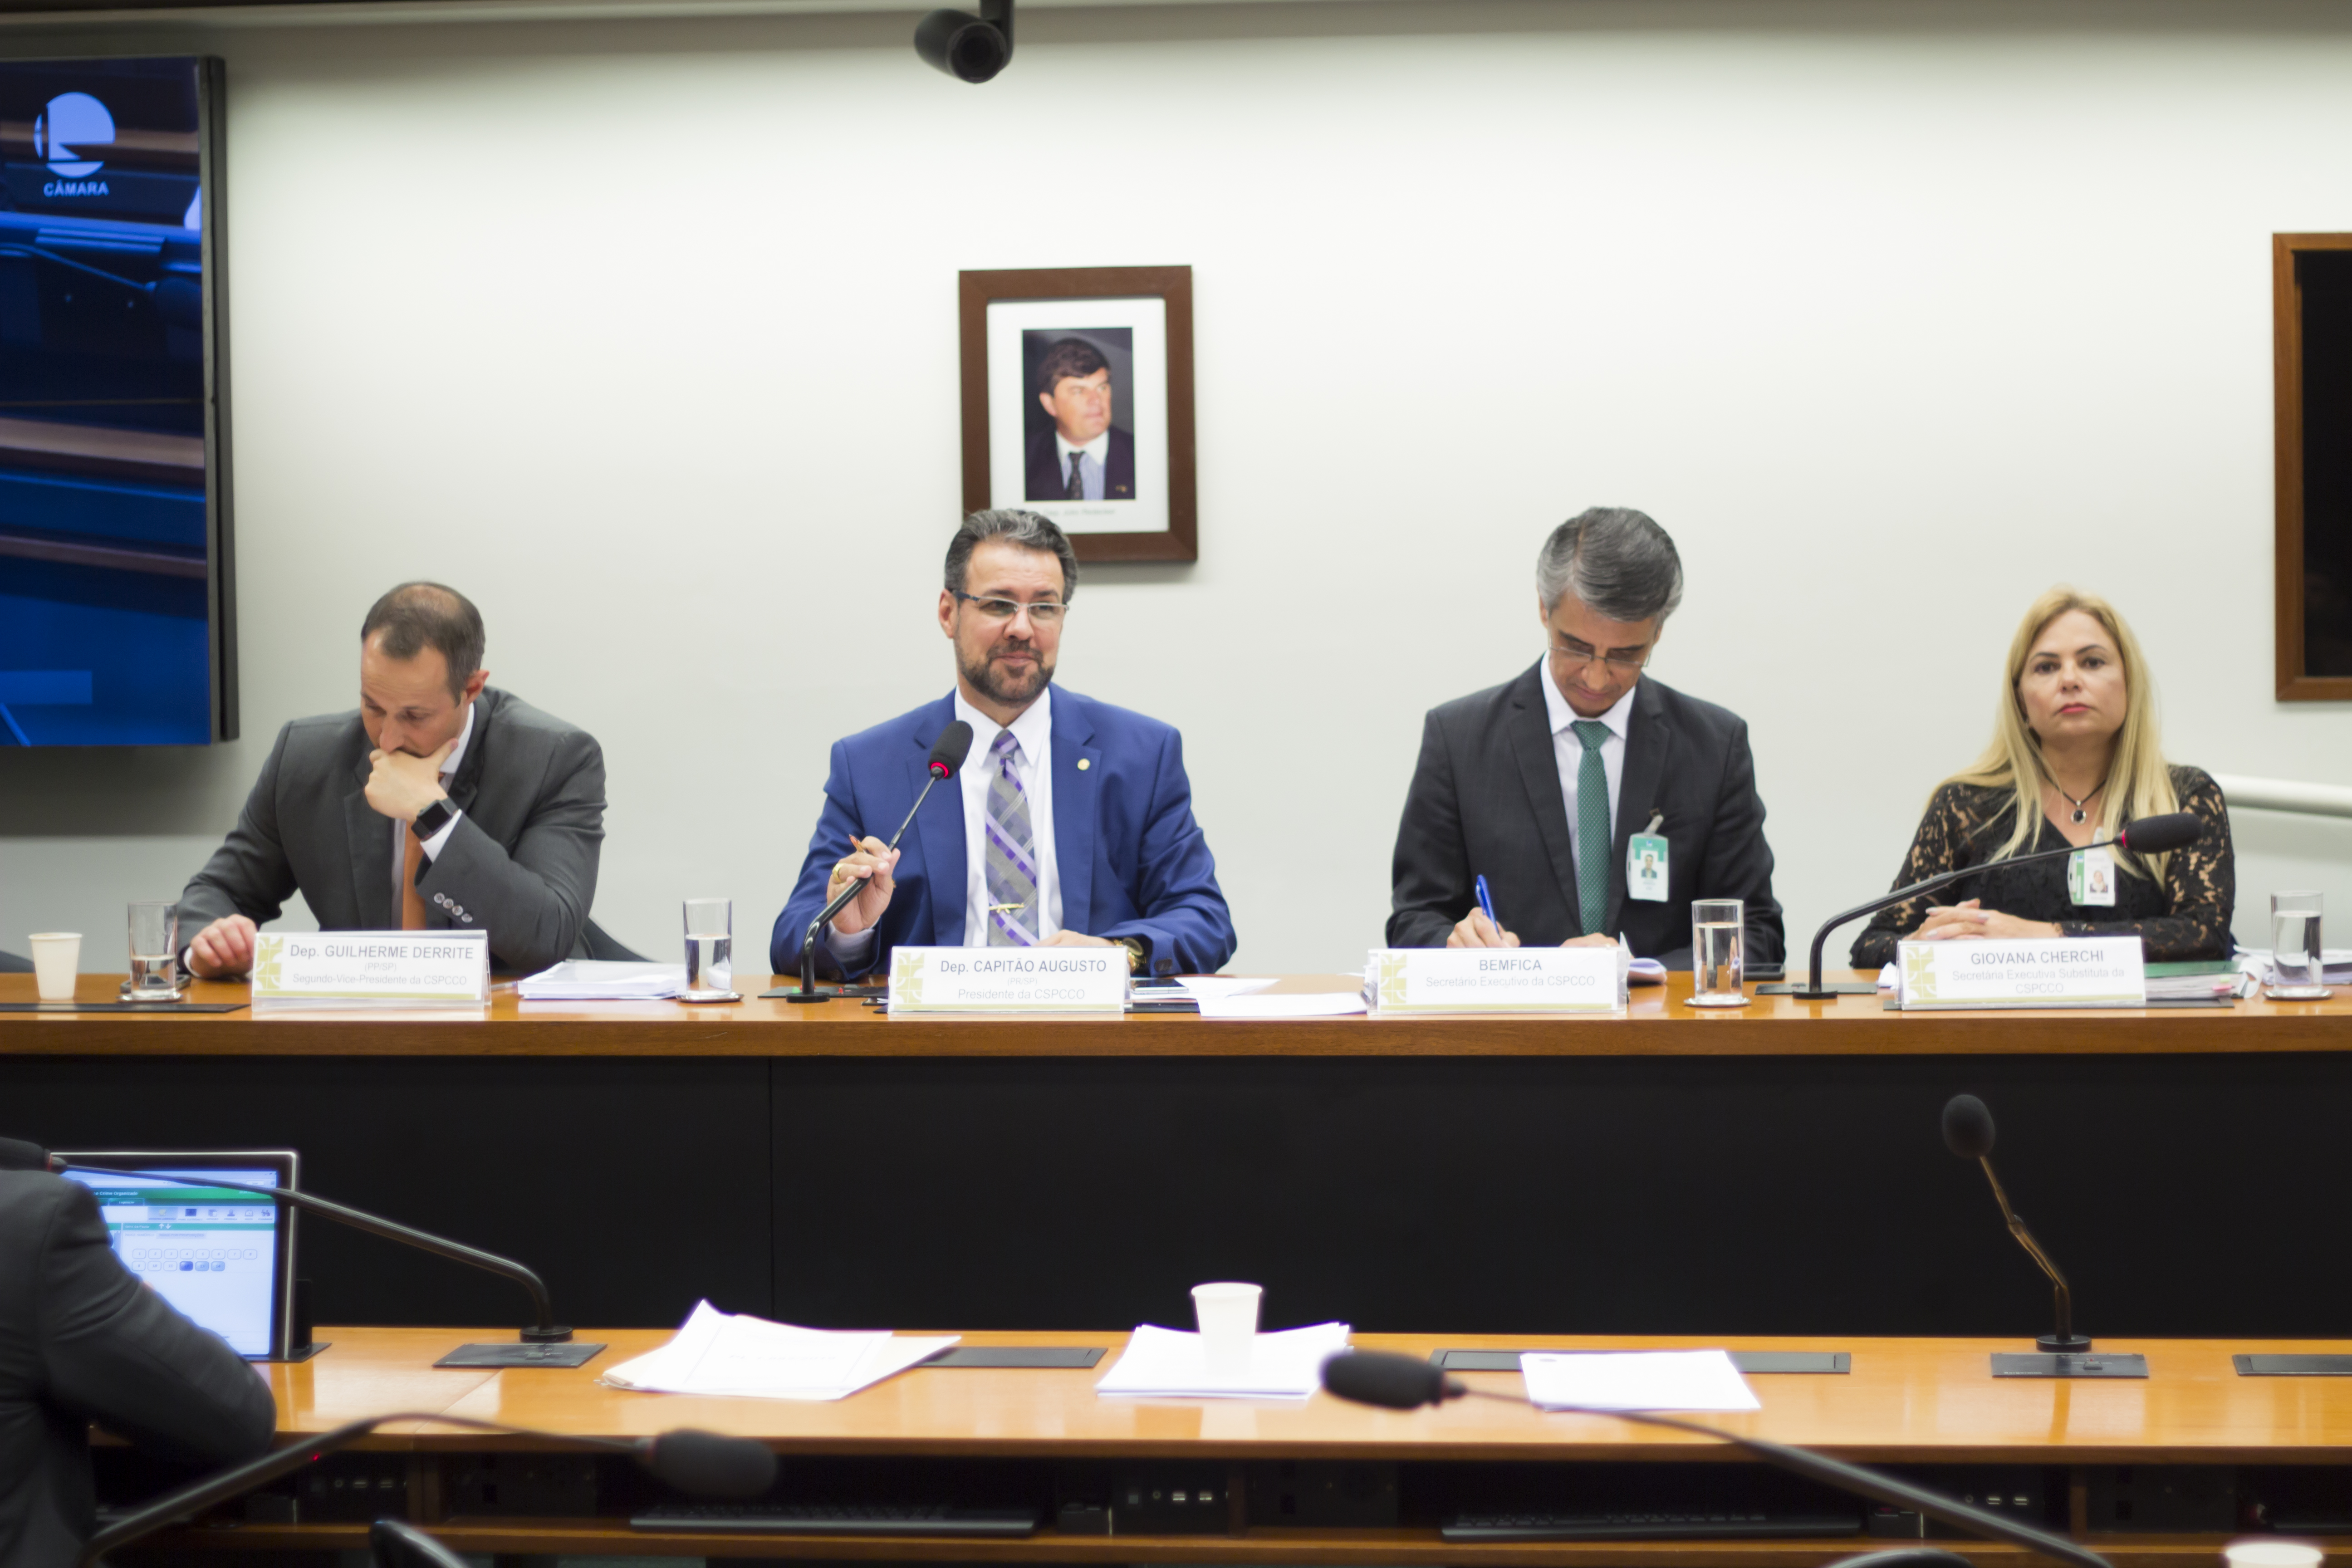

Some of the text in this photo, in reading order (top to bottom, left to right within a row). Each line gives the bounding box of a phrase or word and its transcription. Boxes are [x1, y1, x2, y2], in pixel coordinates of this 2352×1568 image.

[44, 180, 109, 196] CÂMARA
[290, 944, 474, 960] Dep. GUILHERME DERRITE
[1971, 950, 2103, 965] GIOVANA CHERCHI
[364, 962, 397, 972] (PP/SP)
[940, 958, 1107, 975] Dep. CAPITÃO AUGUSTO
[1480, 959, 1542, 971] BEMFICA
[293, 974, 467, 985] Segundo-Vice-Presidente da CSPCCO
[1952, 967, 2125, 981] Secretária Executiva Substituta da
[1426, 975, 1595, 987] Secretário Executivo da CSPCCO
[958, 989, 1085, 1000] Presidente da CSPCCO
[2015, 983, 2064, 994] CSPCCO
